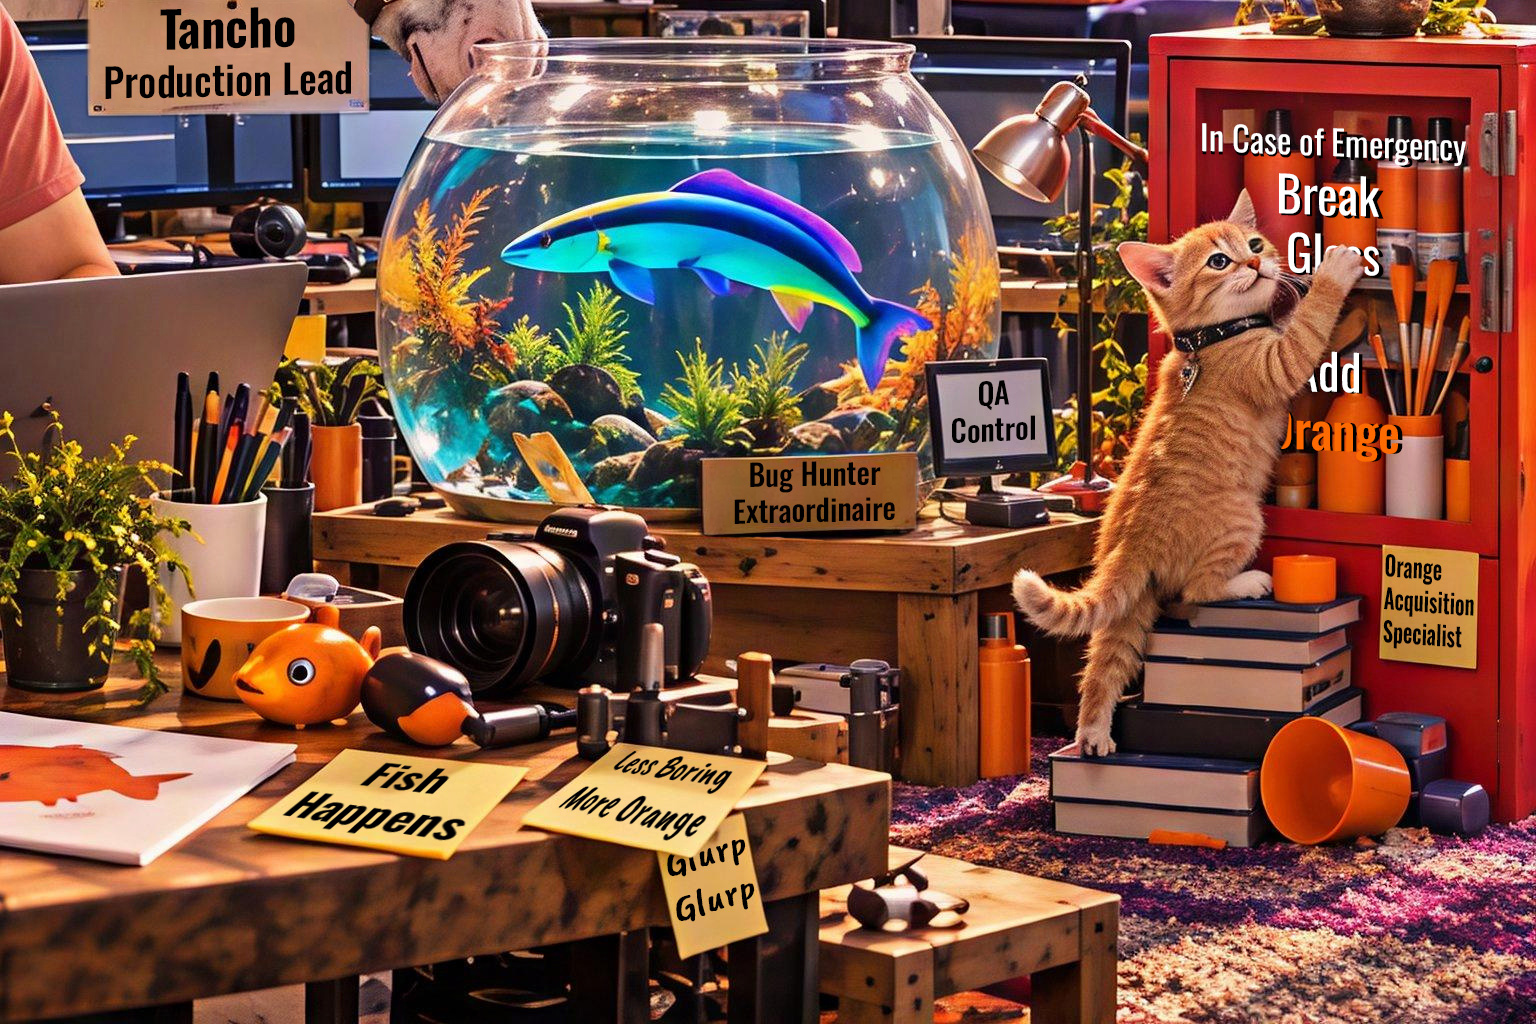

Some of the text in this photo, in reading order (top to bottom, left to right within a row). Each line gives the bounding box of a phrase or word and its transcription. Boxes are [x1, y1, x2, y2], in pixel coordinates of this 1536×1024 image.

[160, 7, 295, 50] Tancho
[105, 61, 352, 99] Production Lead
[1201, 123, 1466, 166] In Case of Emergency
[1278, 173, 1380, 218] Break
[1287, 232, 1380, 277] Gls
[1308, 352, 1360, 394] dd
[978, 380, 1010, 410] QA
[951, 415, 1036, 444] Control
[749, 461, 880, 493] Bug Hunter
[734, 497, 896, 525] Extraordinaire
[1385, 554, 1442, 585] Orange
[1384, 587, 1474, 617] Acquisition
[1383, 620, 1462, 649] Specialist
[360, 762, 450, 797] Fish
[613, 750, 733, 793] Less Boring
[283, 791, 465, 841] Happens
[559, 786, 706, 841] More Orange
[676, 883, 754, 921] Glurp
